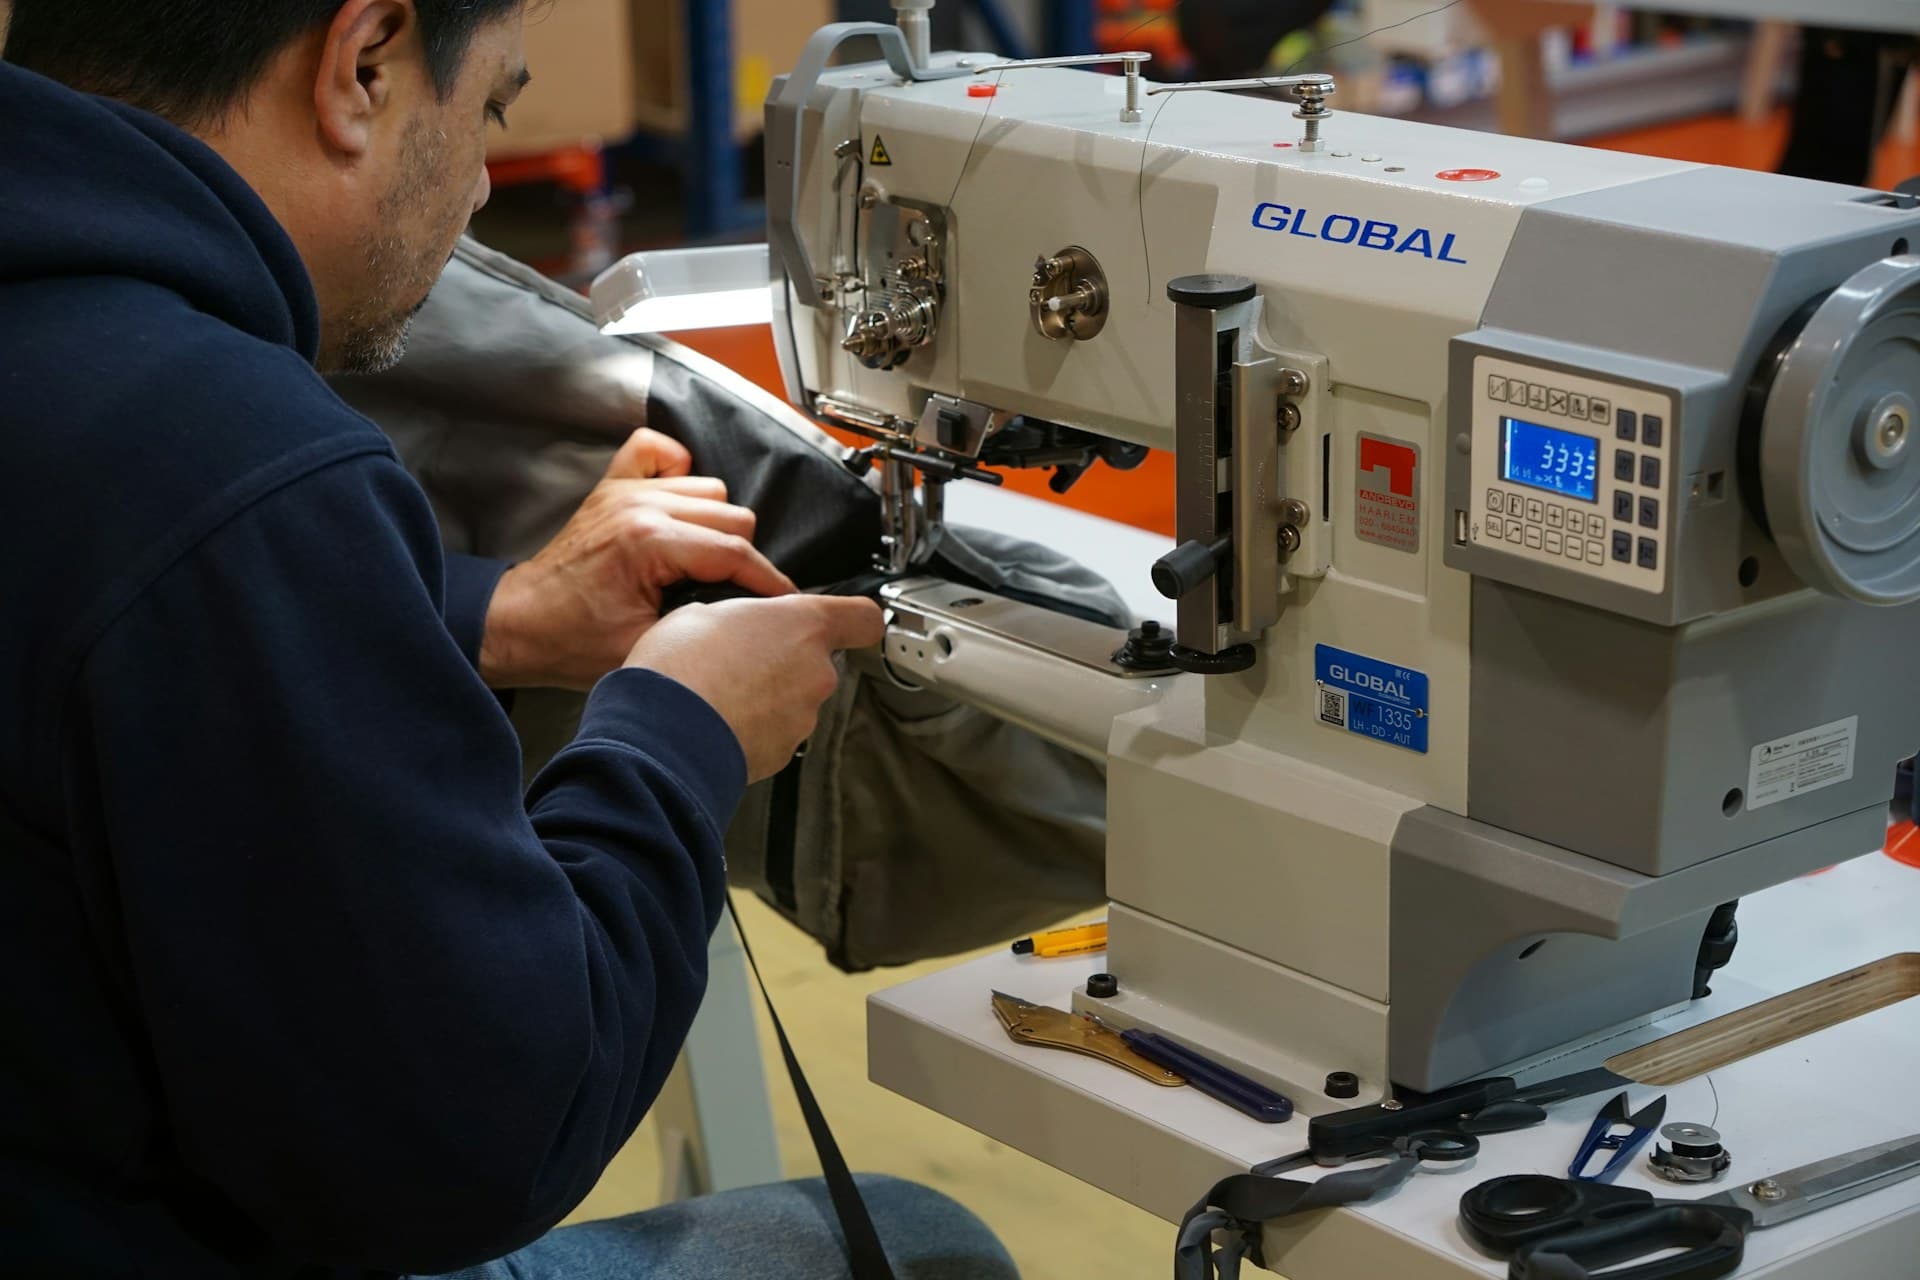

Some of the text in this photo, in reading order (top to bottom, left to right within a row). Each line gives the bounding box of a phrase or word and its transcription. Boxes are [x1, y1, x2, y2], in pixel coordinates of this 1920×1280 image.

[1251, 202, 1467, 264] GLOBAL
[1361, 491, 1415, 510] ANDREVO
[1360, 503, 1415, 525] HAARLEM
[1487, 521, 1499, 533] SEL
[1329, 664, 1411, 700] GLOBAL
[1378, 705, 1412, 731] 1335
[1353, 720, 1364, 731] LH
[1371, 724, 1386, 738] DD
[1394, 732, 1411, 745] AUT
